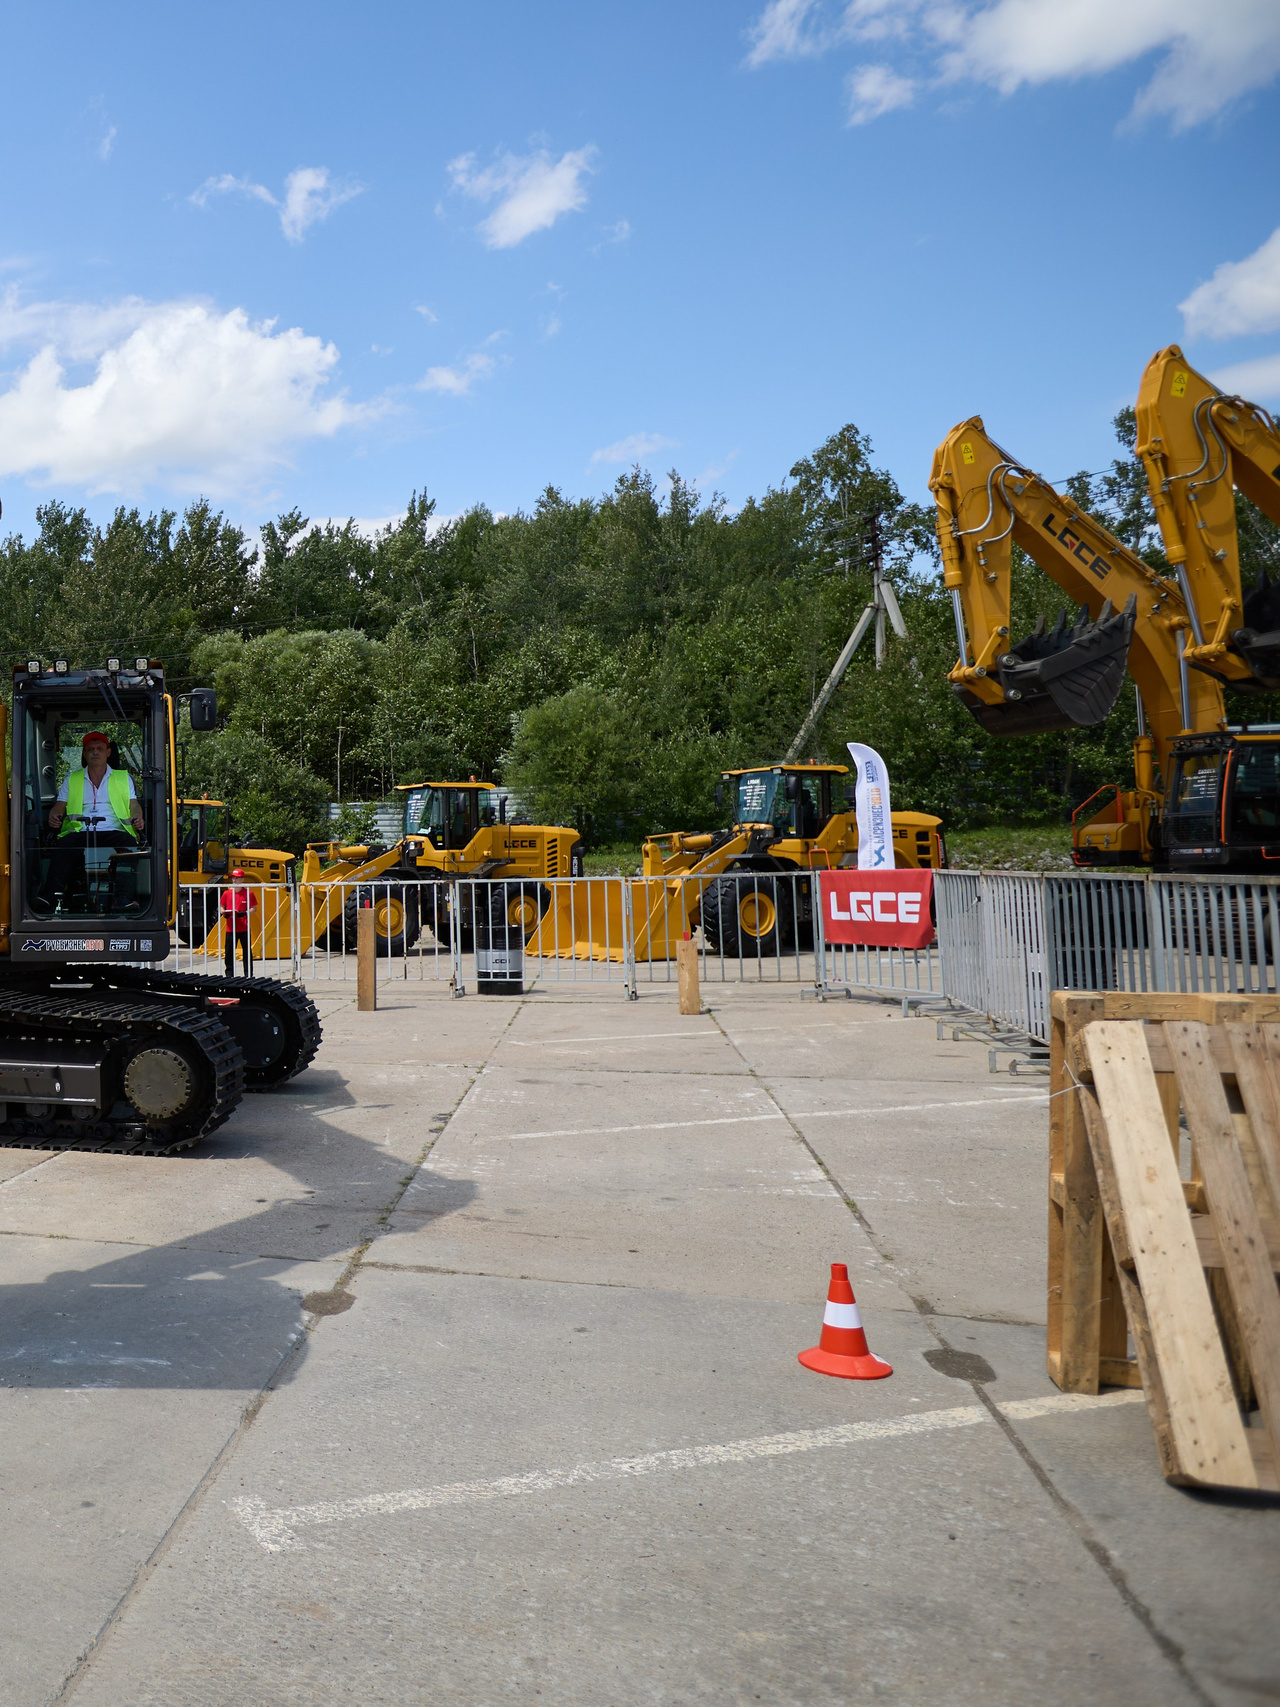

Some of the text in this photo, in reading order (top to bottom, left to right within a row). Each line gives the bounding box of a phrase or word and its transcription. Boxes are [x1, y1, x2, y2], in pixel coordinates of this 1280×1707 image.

[1042, 513, 1112, 580] LGCE
[504, 840, 536, 848] LGCE
[232, 860, 264, 868] LGCE
[830, 891, 922, 923] LGCE
